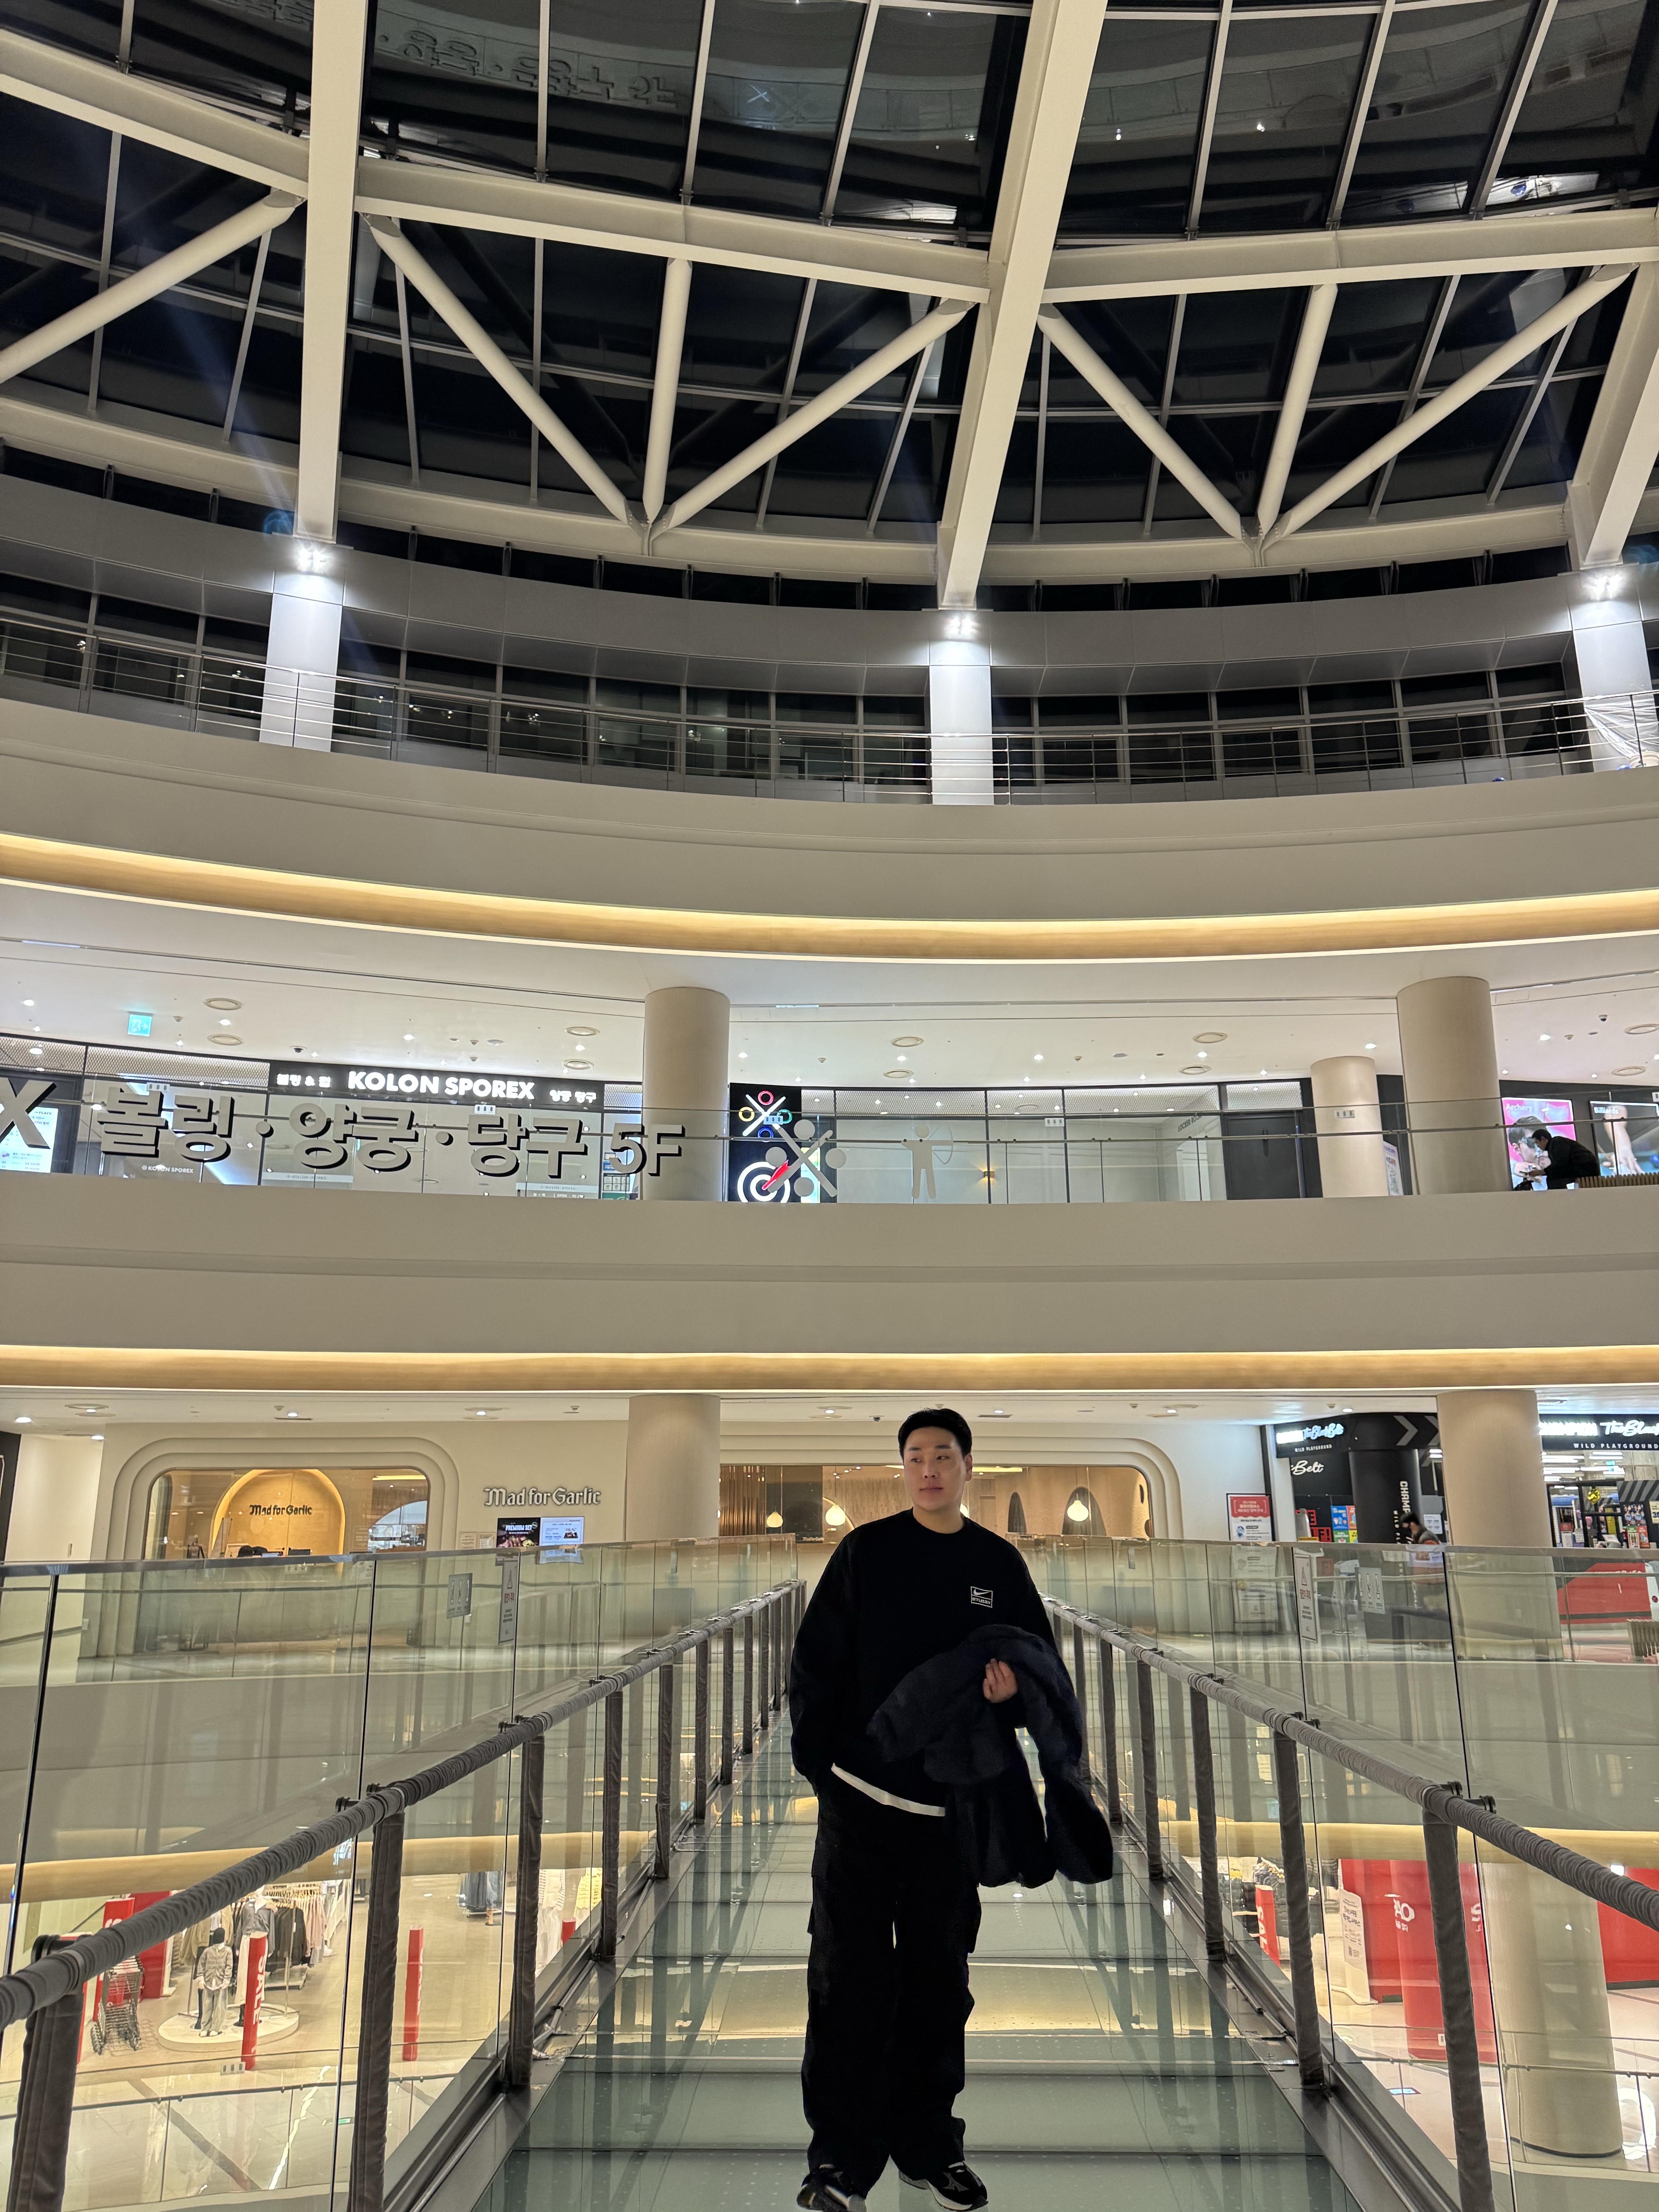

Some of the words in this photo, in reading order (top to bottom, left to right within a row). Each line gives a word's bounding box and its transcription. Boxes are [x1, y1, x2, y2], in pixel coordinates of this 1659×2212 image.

[348, 1071, 439, 1094] KOLON
[445, 1077, 535, 1099] SPOREX
[1506, 1103, 1533, 1112] Archery
[609, 1123, 685, 1176] 5F
[249, 1504, 272, 1515] Mad
[273, 1504, 285, 1515] for
[286, 1504, 313, 1515] Garlic
[483, 1487, 526, 1506] Mad
[528, 1487, 551, 1506] for
[551, 1486, 601, 1506] Garlic
[1254, 1905, 1268, 1950] SAL
[252, 1955, 266, 2025] SALE
